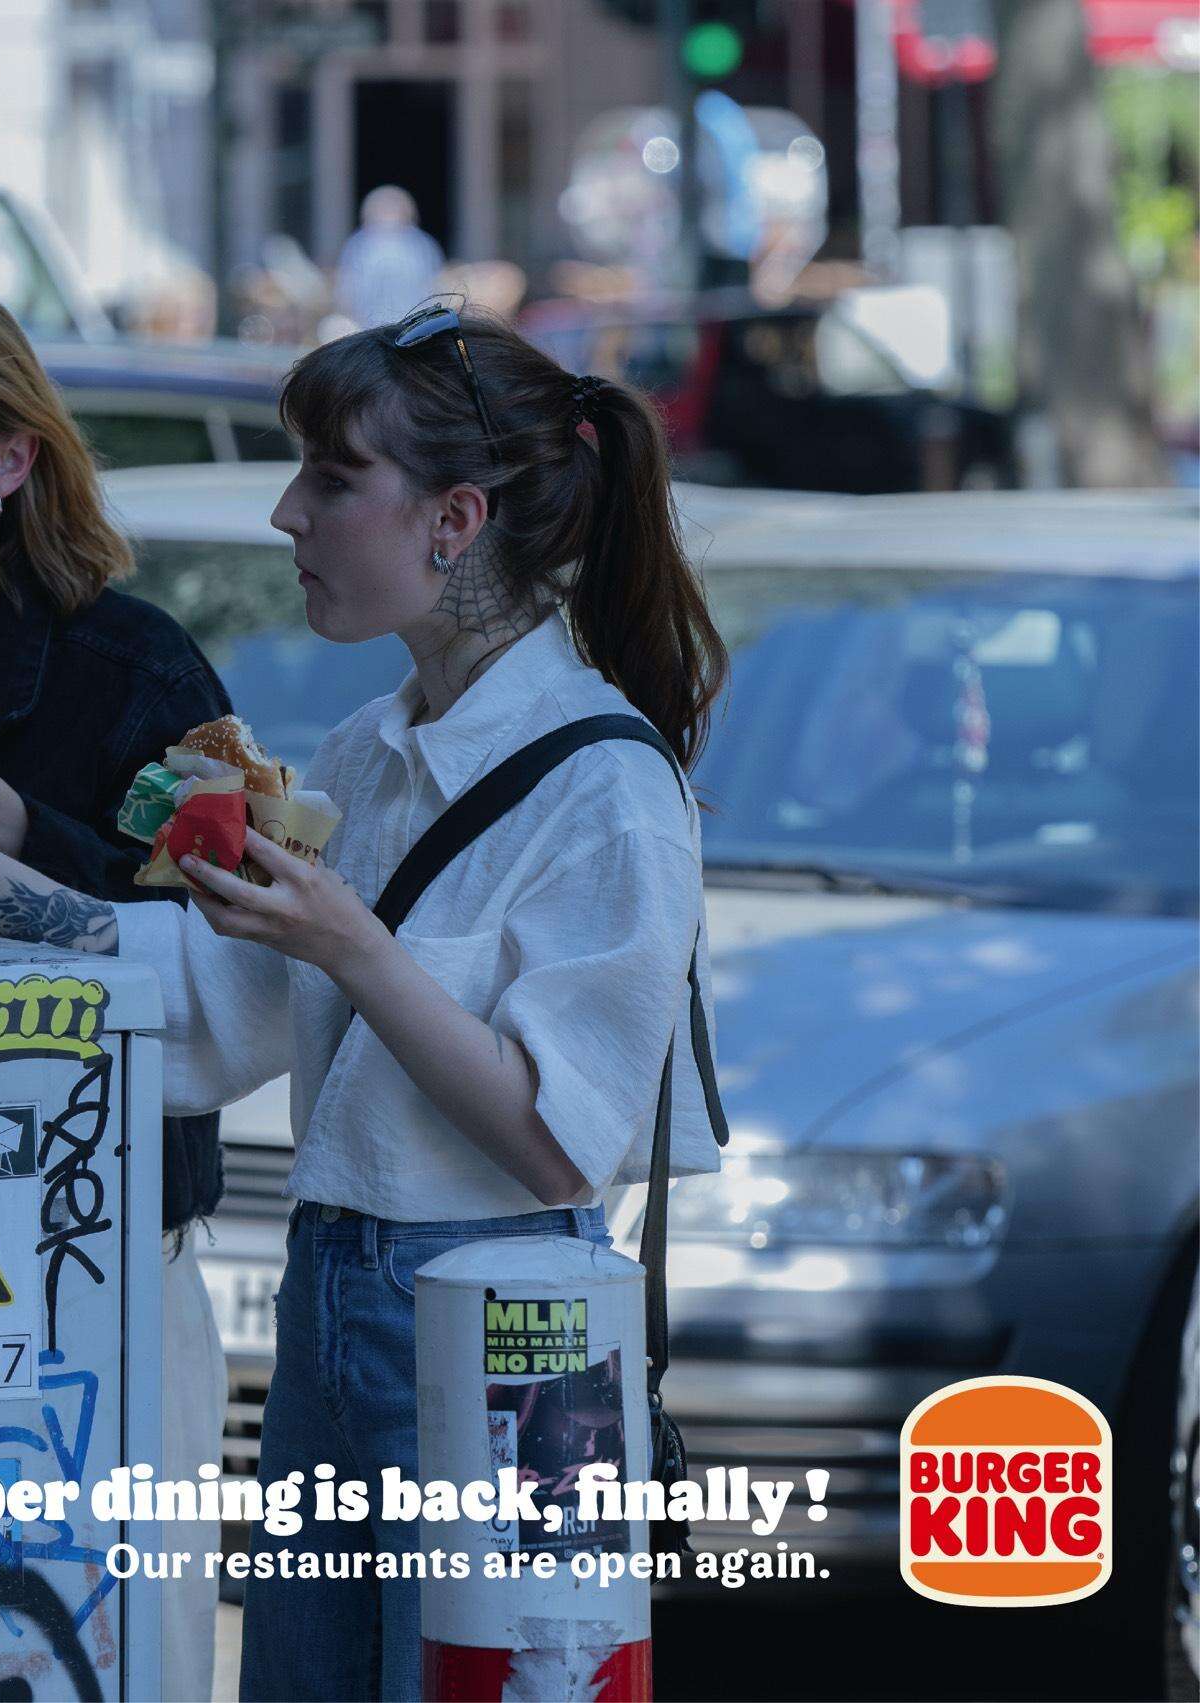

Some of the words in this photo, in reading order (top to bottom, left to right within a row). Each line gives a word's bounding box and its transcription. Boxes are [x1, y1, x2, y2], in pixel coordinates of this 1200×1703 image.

[486, 1301, 586, 1332] MLM
[487, 1336, 527, 1347] MIRO
[487, 1353, 528, 1373] NO
[533, 1353, 586, 1373] FUN
